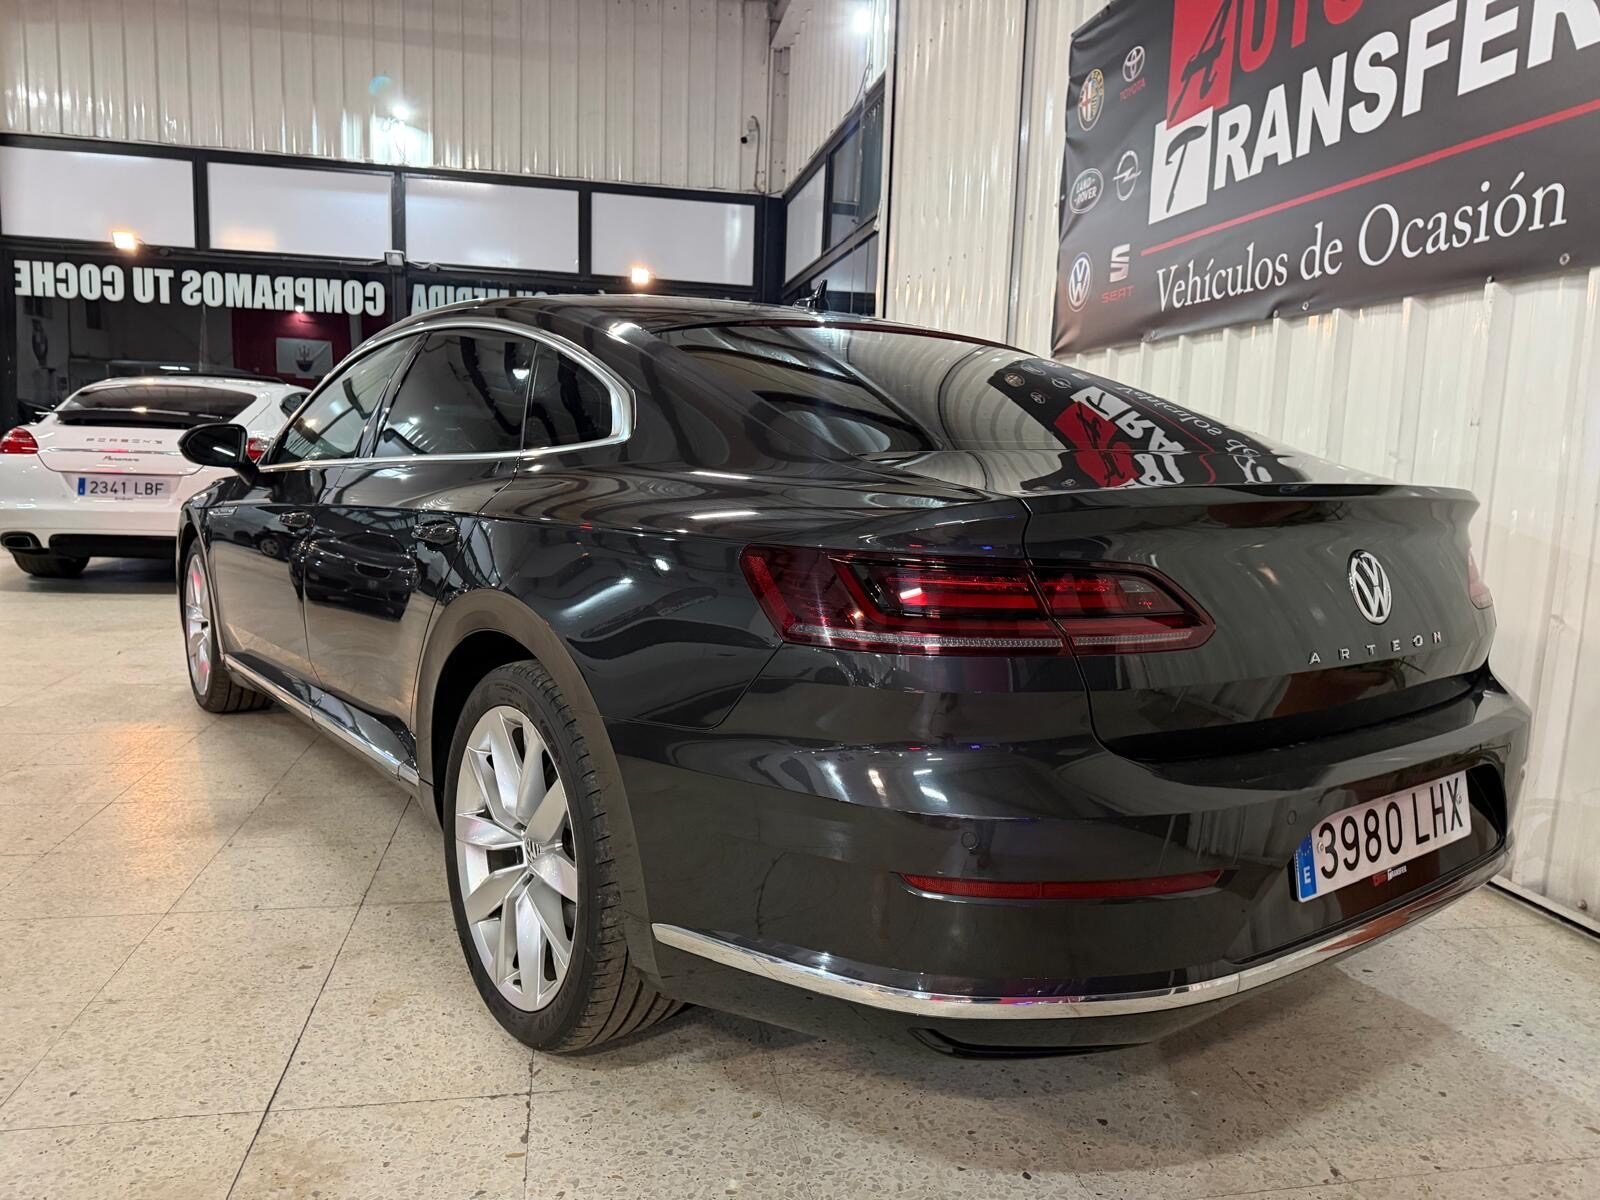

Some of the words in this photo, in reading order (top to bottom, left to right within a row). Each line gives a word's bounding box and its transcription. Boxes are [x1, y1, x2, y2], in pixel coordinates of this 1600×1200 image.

[1148, 0, 1600, 224] TRANSFER
[1167, 0, 1364, 123] AU
[1101, 285, 1135, 303] SEAT
[1156, 243, 1288, 311] Vehículos
[1300, 222, 1343, 281] de
[1357, 172, 1567, 266] Ocasión
[90, 480, 126, 495] 2341
[134, 481, 164, 496] LBF
[1308, 631, 1442, 665] ARTEON
[1303, 865, 1311, 884] E
[1318, 801, 1403, 879] 3980
[1412, 777, 1463, 847] LHX
